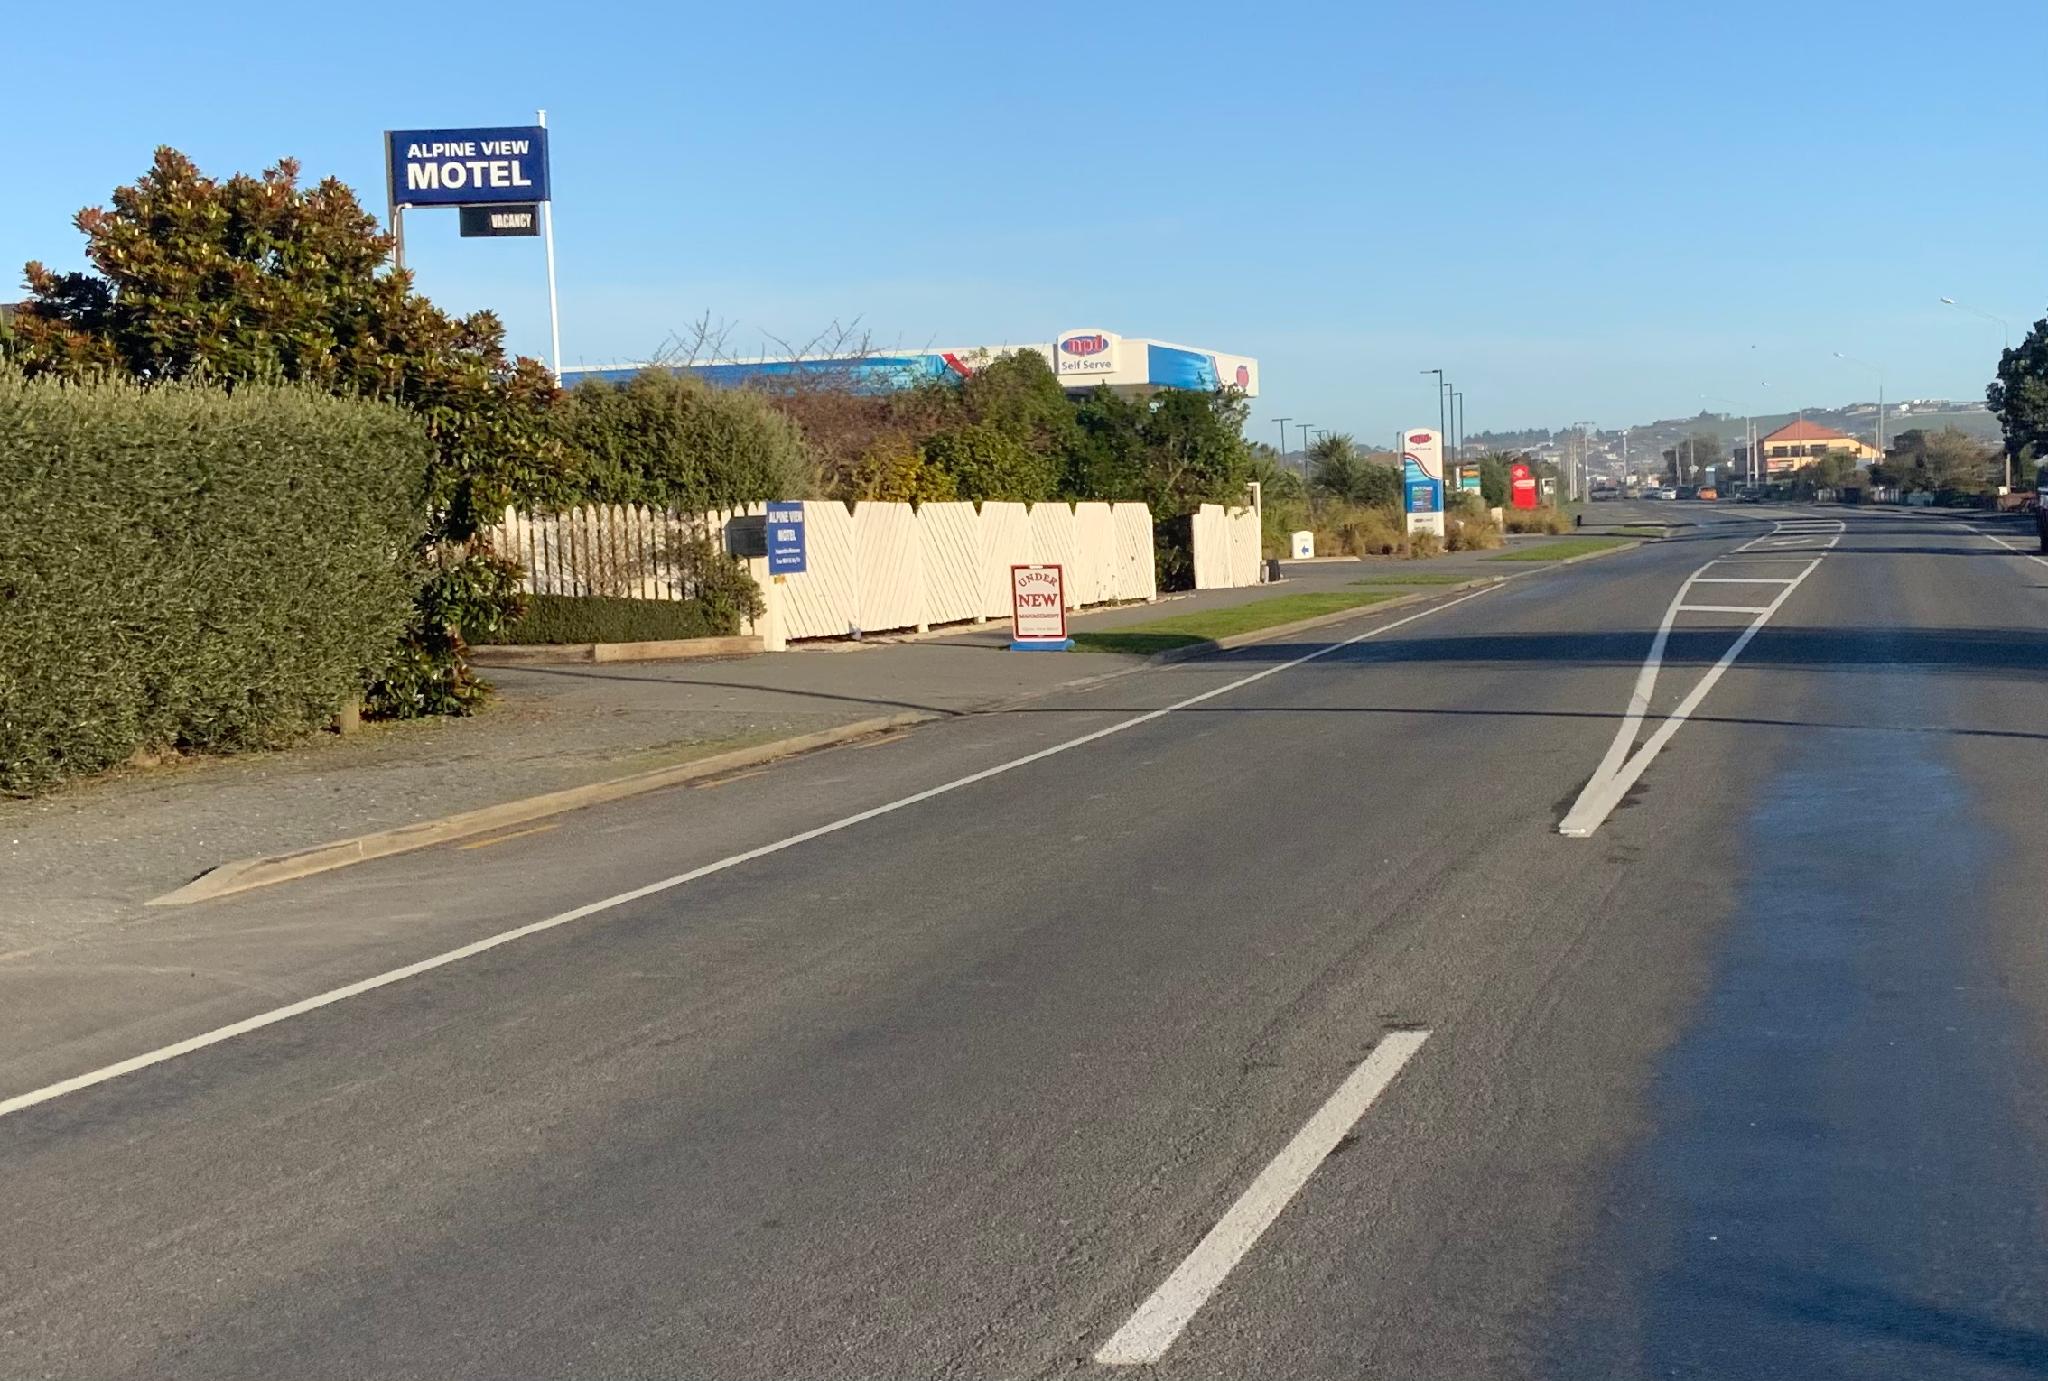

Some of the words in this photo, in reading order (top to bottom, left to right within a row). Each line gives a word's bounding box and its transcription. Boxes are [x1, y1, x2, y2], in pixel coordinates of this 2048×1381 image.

[408, 143, 475, 158] ALPINE
[480, 140, 529, 156] VIEW
[407, 160, 532, 190] MOTEL
[491, 213, 532, 229] VACANCY
[1062, 359, 1080, 370] Self
[1083, 359, 1112, 369] Serve
[1018, 572, 1058, 588] UNDER
[1018, 593, 1058, 607] NEW
